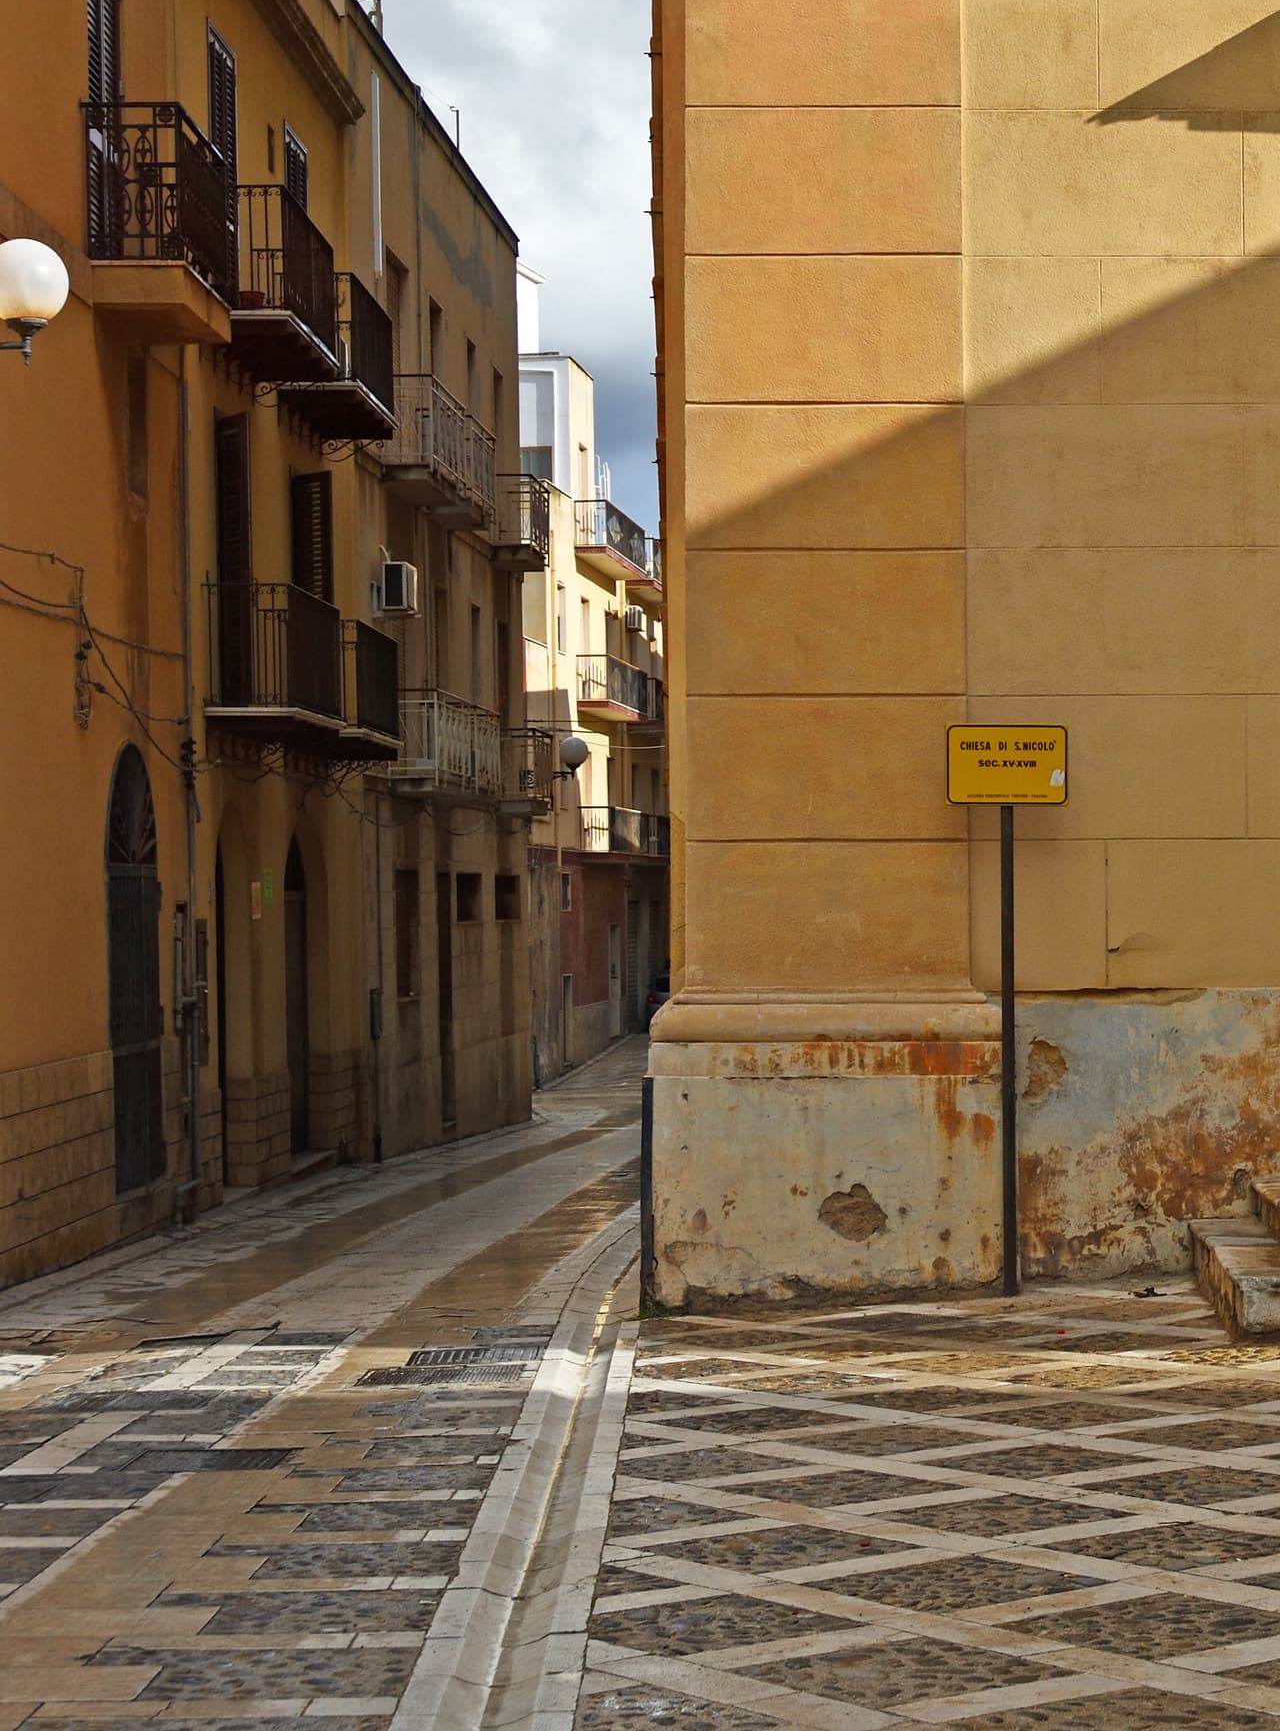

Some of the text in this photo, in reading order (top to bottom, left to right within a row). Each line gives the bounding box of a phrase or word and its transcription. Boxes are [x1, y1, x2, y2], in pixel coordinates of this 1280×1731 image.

[960, 741, 991, 751] CHIESA
[998, 741, 1007, 751] DI
[978, 759, 1000, 768] sec.
